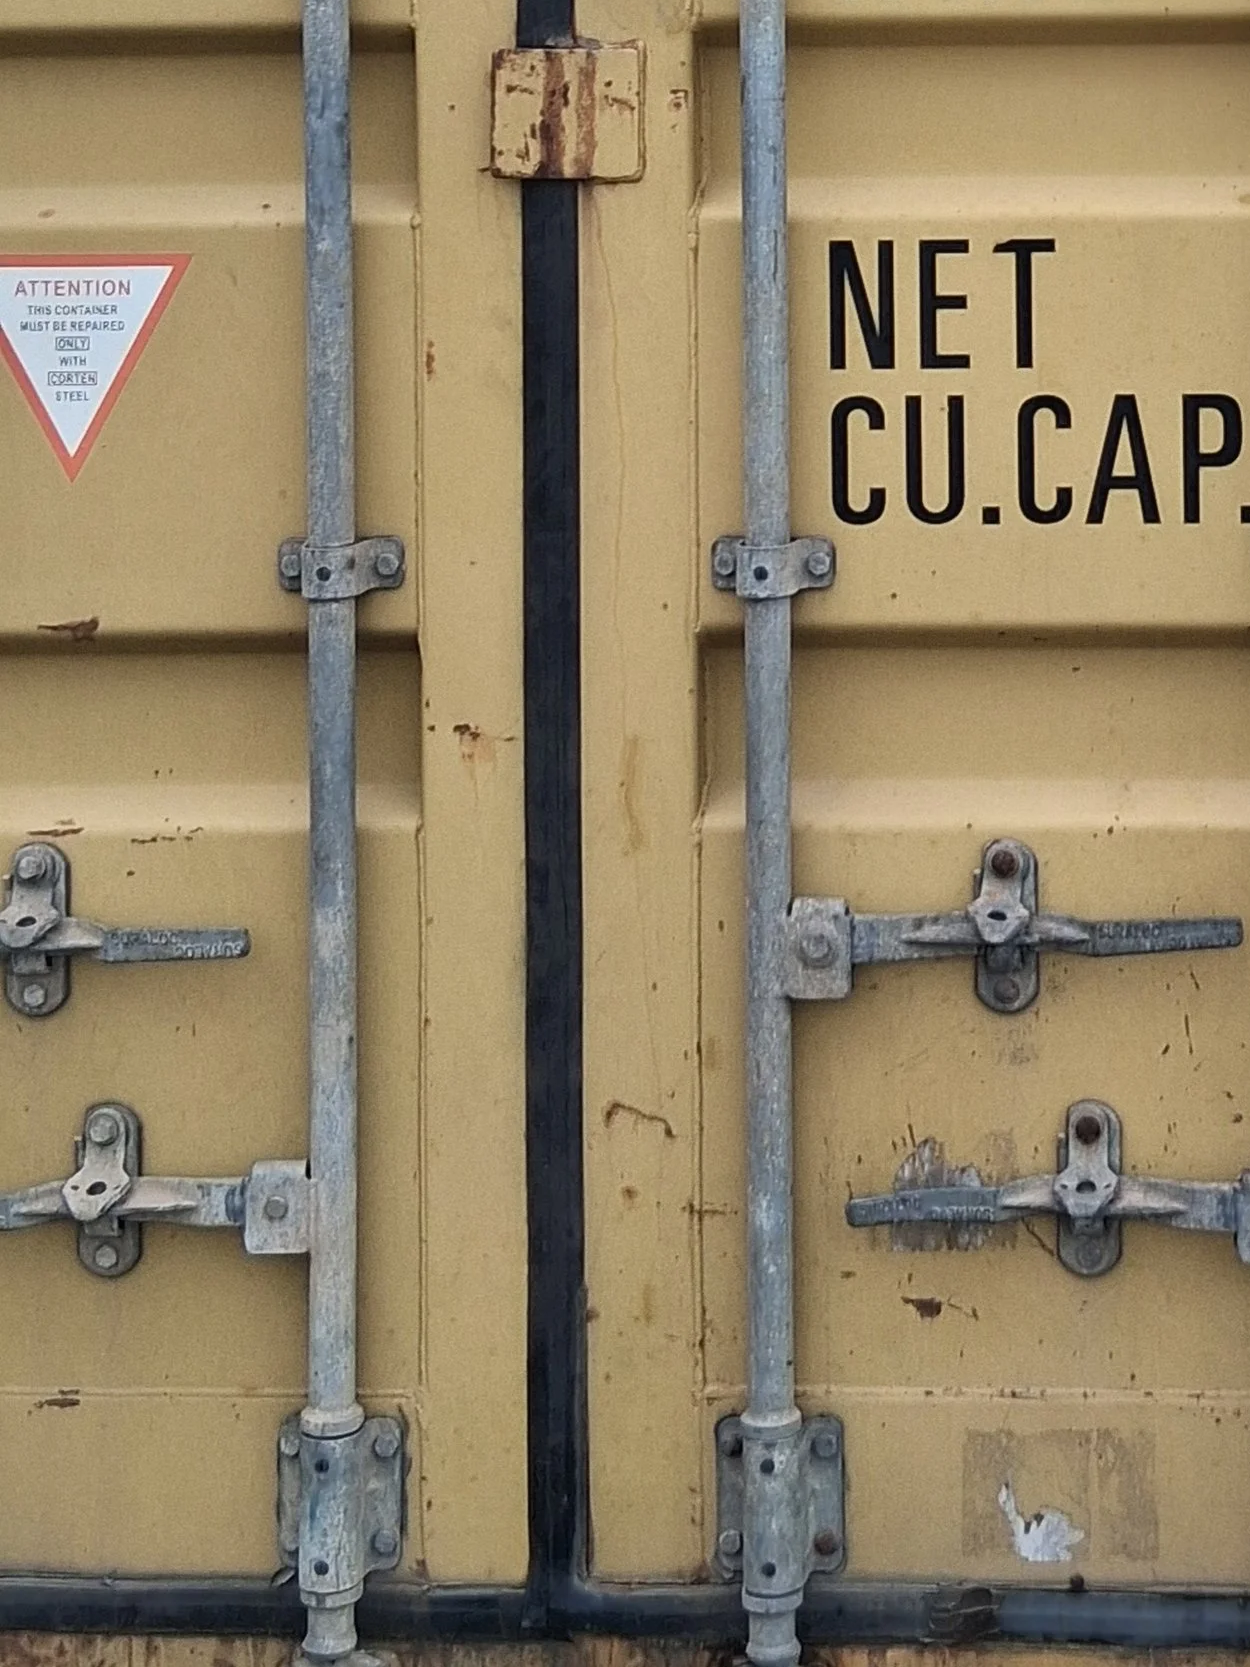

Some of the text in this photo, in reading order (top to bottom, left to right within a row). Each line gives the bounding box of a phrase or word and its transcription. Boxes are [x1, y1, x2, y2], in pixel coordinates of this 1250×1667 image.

[15, 279, 131, 297] ATTENTION
[27, 304, 118, 316] THIS CONTAINER
[828, 238, 1056, 370] NET
[20, 320, 125, 332] MUST BE REPAIRED
[58, 338, 87, 349] ONLY
[60, 355, 87, 366] WITH
[55, 390, 89, 402] STEEL
